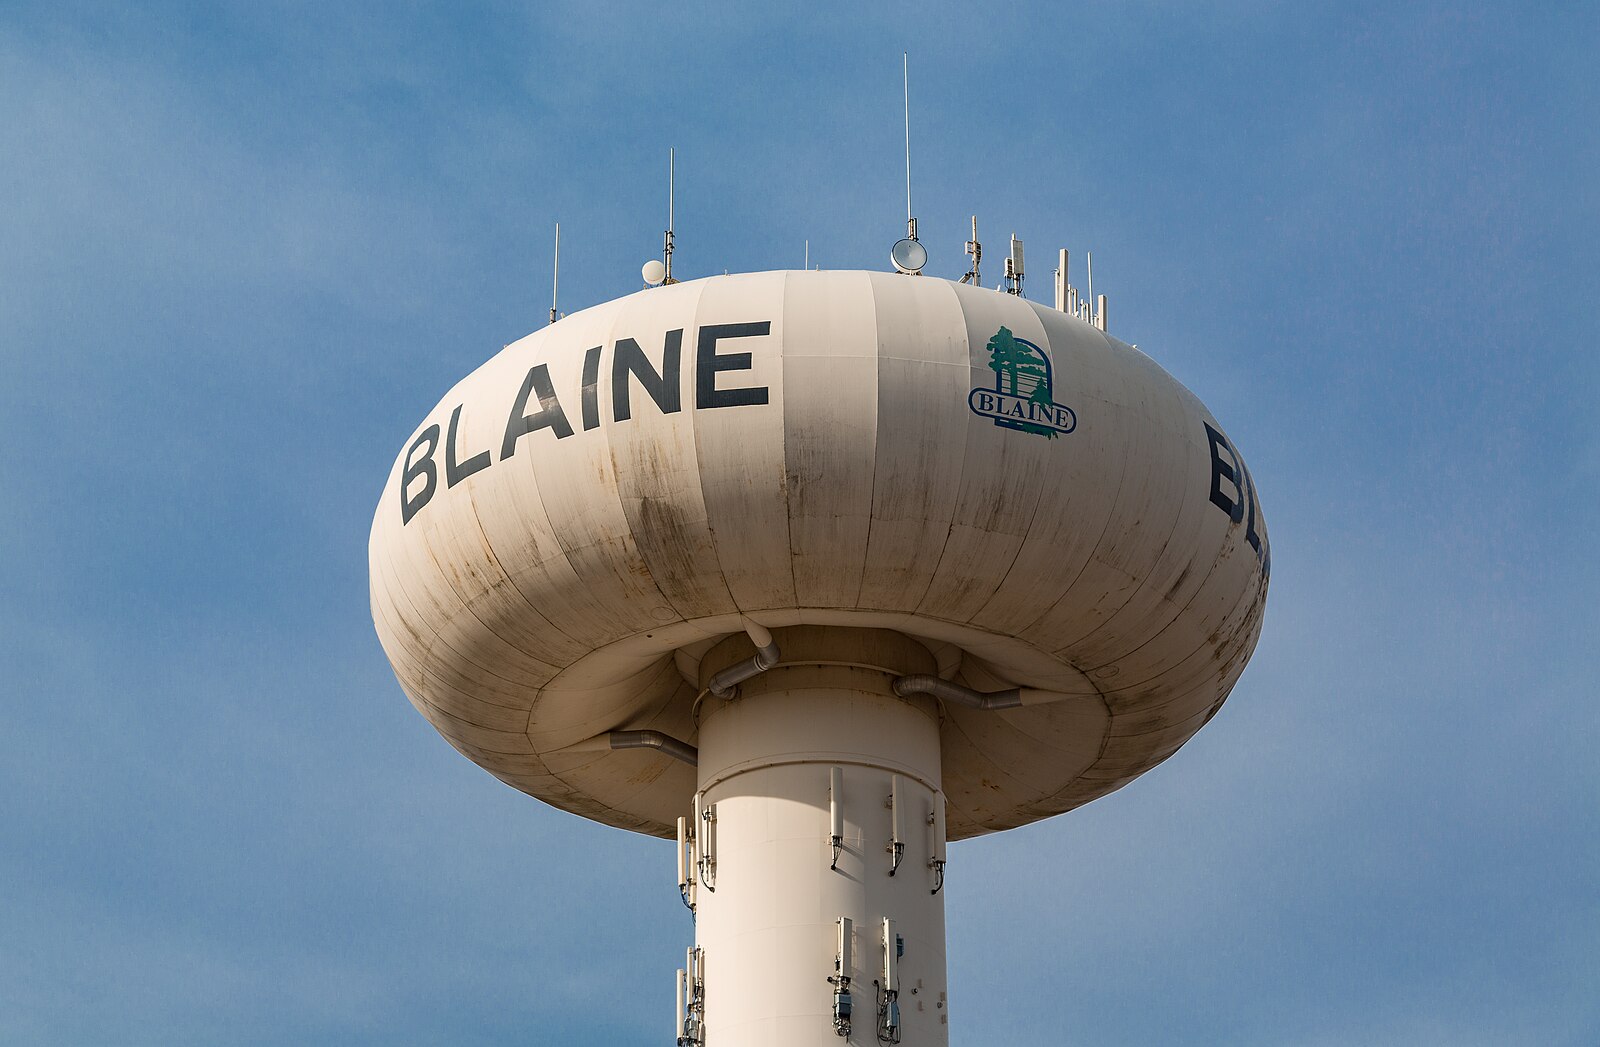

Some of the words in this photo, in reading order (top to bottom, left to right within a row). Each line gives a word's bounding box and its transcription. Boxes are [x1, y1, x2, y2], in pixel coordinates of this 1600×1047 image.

[401, 321, 771, 526] BLAINE
[978, 393, 1068, 427] BLAINE
[1203, 421, 1271, 577] BL
